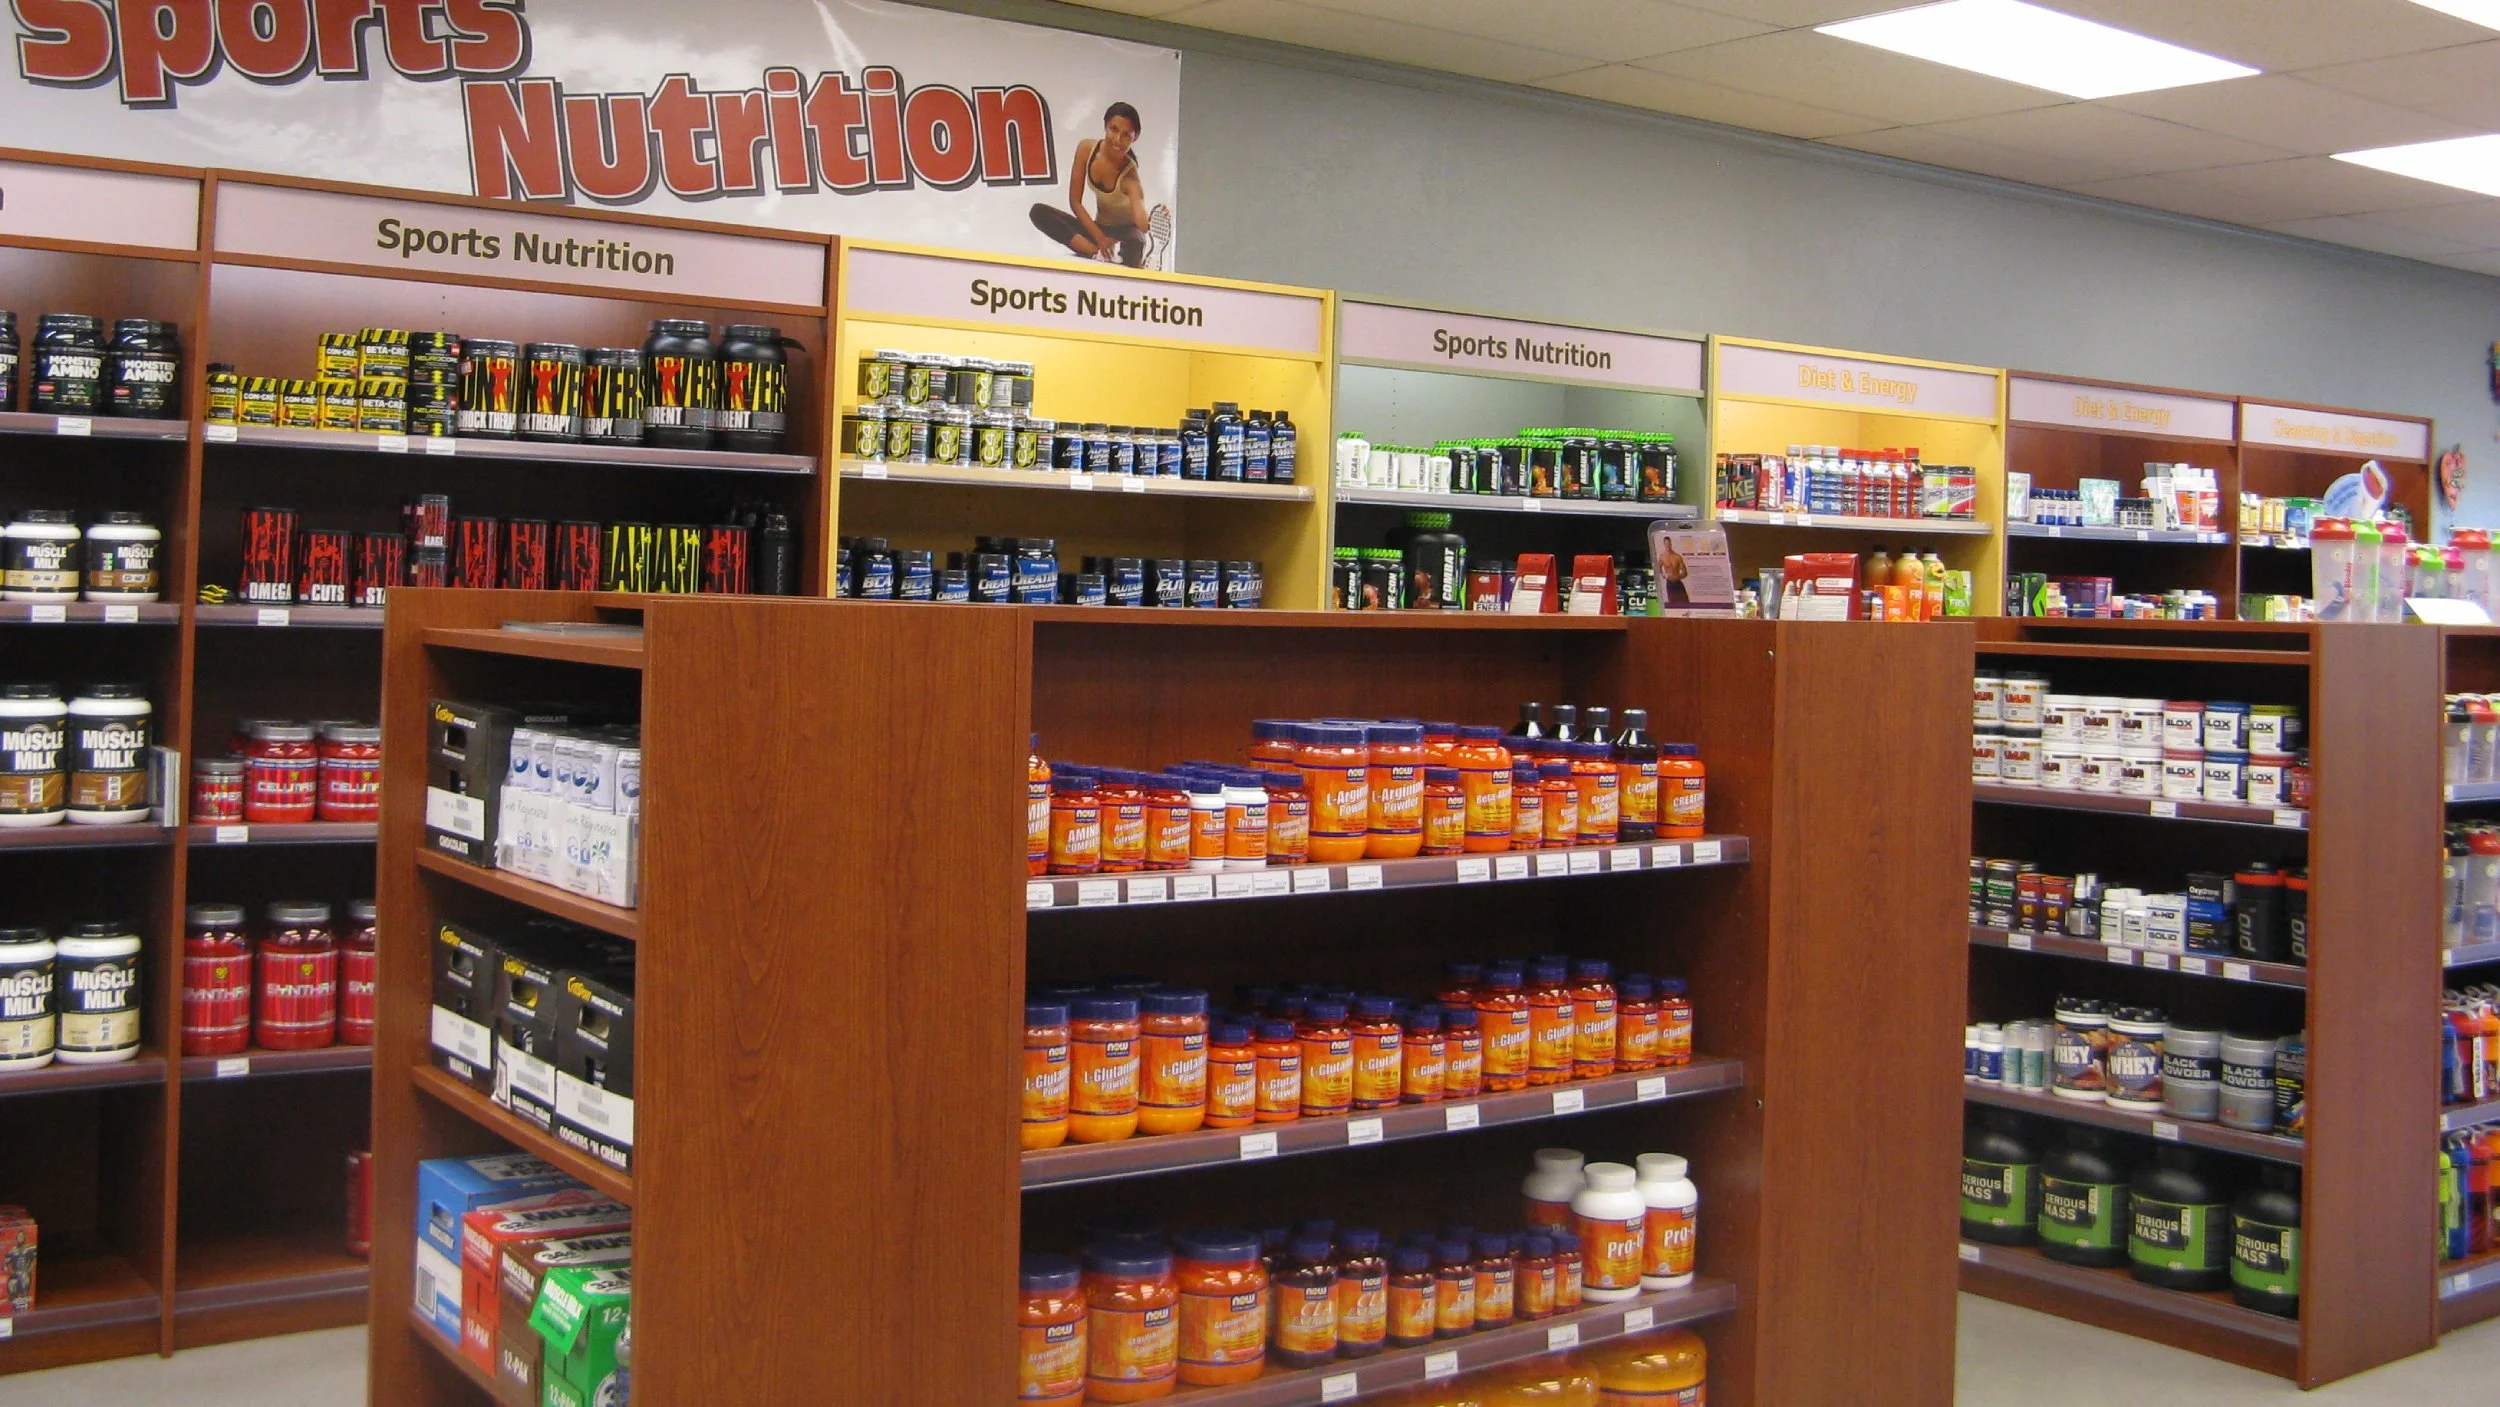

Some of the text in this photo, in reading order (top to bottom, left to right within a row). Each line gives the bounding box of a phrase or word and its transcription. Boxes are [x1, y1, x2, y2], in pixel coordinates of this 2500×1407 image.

[18, 0, 530, 104] Sports
[463, 66, 1057, 201] Nutrition
[377, 218, 674, 275] Sports Nutrition
[970, 278, 1203, 326] Sports Nutrition
[1433, 329, 1611, 369] Sports Nutrition
[49, 355, 101, 367] MONSTER
[125, 360, 176, 371] MONSTER
[48, 365, 99, 379] AMINO
[123, 370, 173, 383] AMINO
[868, 366, 881, 395] C4
[909, 371, 921, 400] C4
[1799, 365, 1917, 403] Diet & Energy
[457, 411, 486, 428] SHOCK
[2073, 396, 2170, 428] Diet & Energy
[532, 414, 571, 432] THERAPY
[860, 424, 872, 454] C4
[891, 424, 902, 454] C4
[939, 429, 950, 458] C4
[985, 433, 995, 461] C4
[1017, 435, 1028, 464] C4
[27, 546, 67, 558] MUSCLE
[118, 547, 154, 558] MUSCLE
[34, 558, 60, 569] MILK
[125, 558, 149, 569] MILK
[1442, 547, 1455, 600] COMBAT
[249, 583, 291, 600] OMEGA
[312, 585, 345, 602] CUTS
[3, 730, 64, 751] MUSCLE
[82, 730, 144, 749] MUSCLE
[15, 750, 56, 770] MILK
[93, 749, 135, 768] MILK
[1392, 767, 1414, 776] now
[1120, 805, 1140, 814] now
[2148, 931, 2177, 941] SOLID
[0, 973, 53, 997] MUSCLE
[73, 968, 135, 990] MUSCLE
[4, 995, 46, 1016] MILK
[84, 989, 126, 1009] MILK
[1107, 1042, 1129, 1052] now
[1380, 1036, 1398, 1044] now
[1048, 1047, 1066, 1057] now
[2110, 1056, 2156, 1075] WHEY
[2222, 1063, 2263, 1078] BLACK
[2223, 1074, 2274, 1089] POWDER
[1963, 1174, 2001, 1191] SERIOUS
[1963, 1186, 1992, 1200] MASS
[2044, 1193, 2086, 1210] SERIOUS
[2044, 1203, 2076, 1221] MASS
[2135, 1212, 2178, 1230] SERIOUS
[2135, 1224, 2169, 1243] MASS
[2235, 1234, 2279, 1254] SERIOUS
[2235, 1245, 2268, 1265] MASS
[1231, 1294, 1255, 1306] now
[1306, 1287, 1327, 1296] now
[1145, 1310, 1168, 1322] now
[1047, 1326, 1073, 1338] now
[503, 1349, 529, 1384] 12-PAK
